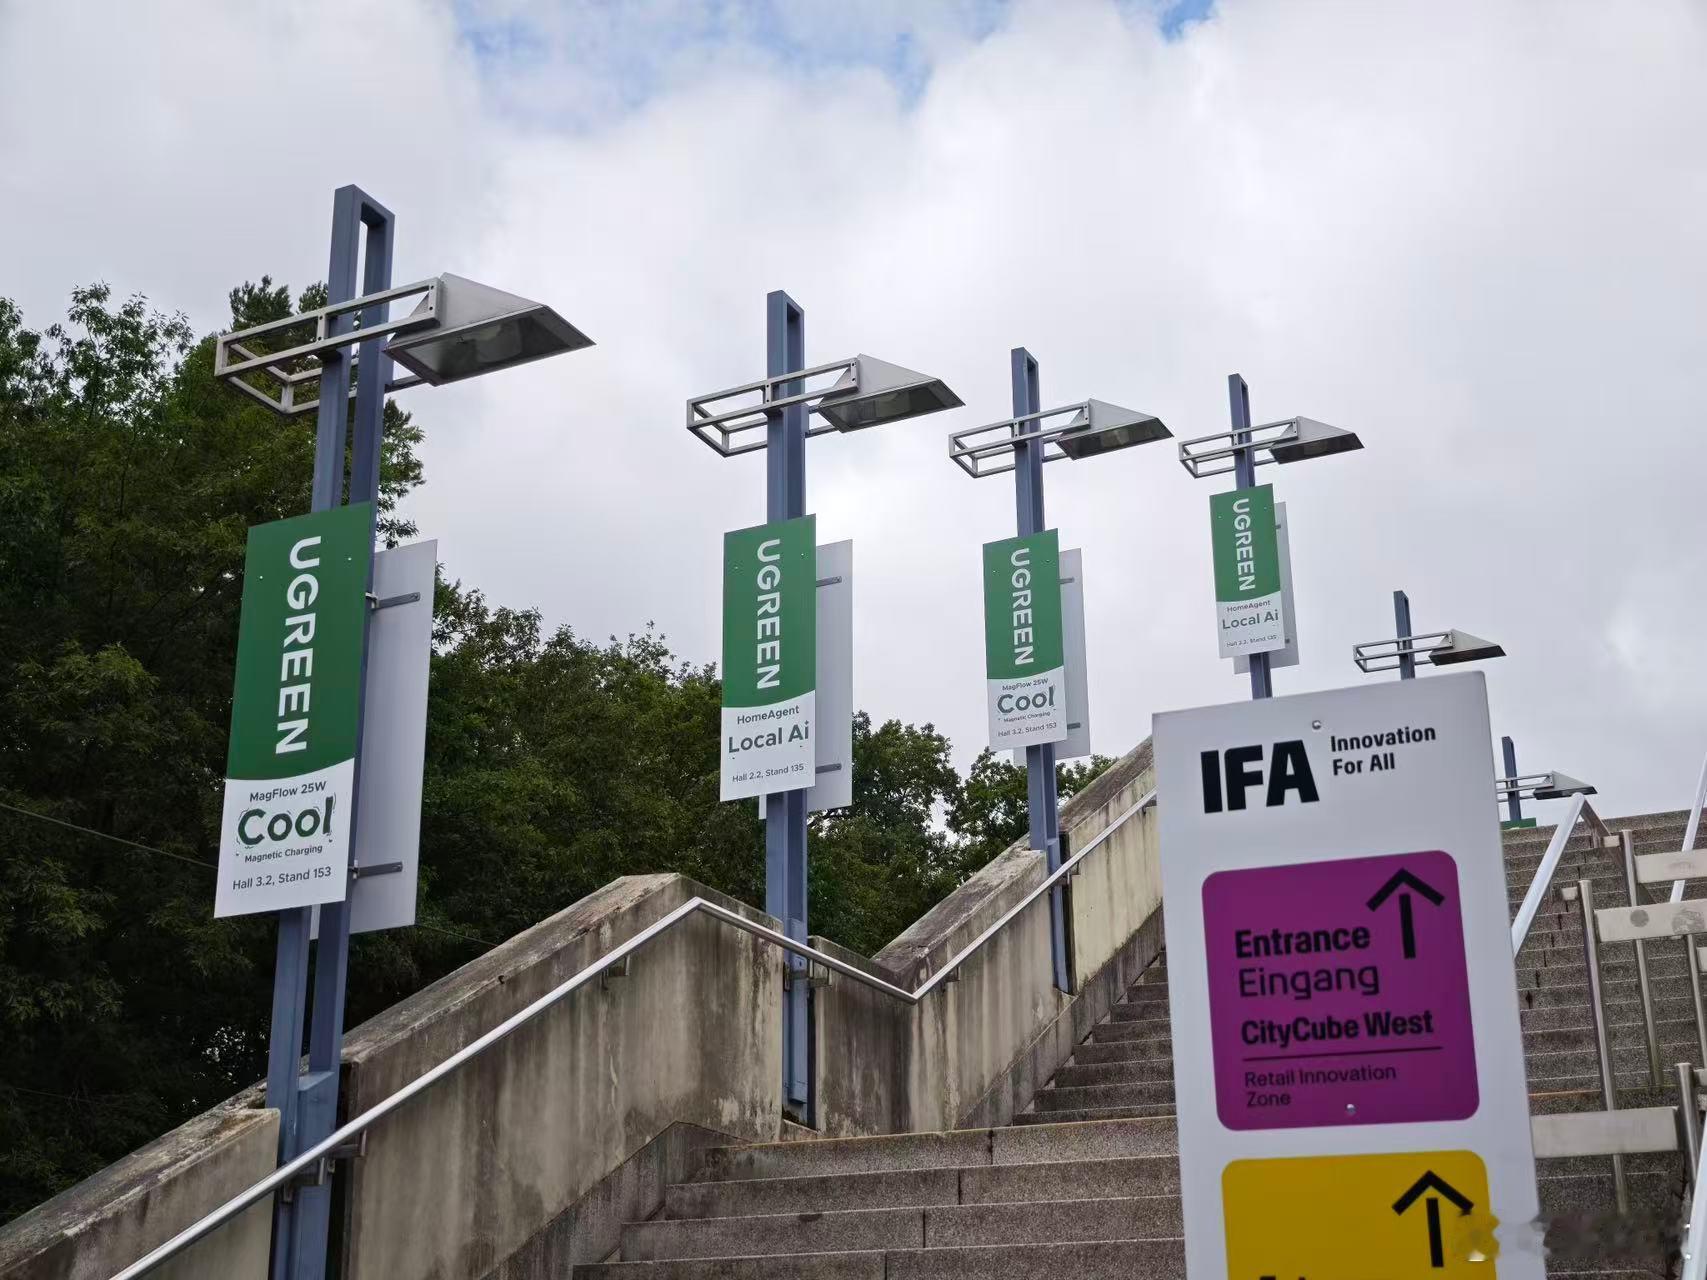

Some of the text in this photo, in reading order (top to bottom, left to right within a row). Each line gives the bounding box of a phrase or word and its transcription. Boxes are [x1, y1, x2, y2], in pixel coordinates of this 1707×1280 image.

[1232, 498, 1256, 591] UGREEN
[756, 538, 781, 690] UGREEN
[1010, 547, 1034, 666] UGREEN
[1226, 600, 1271, 612] HomeAgent
[1222, 609, 1279, 630] Local Ai
[275, 535, 322, 754] UGREEN
[1002, 678, 1049, 691] MagFlow 25W
[997, 685, 1054, 713] Cool
[737, 705, 800, 725] HomeAgent
[728, 720, 809, 753] Local Ai
[997, 729, 1011, 737] Hall
[1025, 725, 1045, 733] Stand
[1330, 726, 1437, 752] Innovation
[732, 763, 804, 783] Hall 2.2, Stand 135
[1200, 739, 1320, 814] IFA
[1332, 752, 1396, 776] For All
[249, 781, 327, 803] MagFlow 25W
[238, 796, 334, 846] Cool
[244, 845, 323, 864] Magnetic Charging
[232, 866, 332, 890] Hall 3.2, Stand 153
[1235, 926, 1371, 959] Entrance
[1238, 965, 1380, 1001] Eingang
[1241, 1010, 1435, 1049] CityCube West
[1244, 1065, 1397, 1088] Retail Innovation
[1246, 1091, 1292, 1109] Zone
